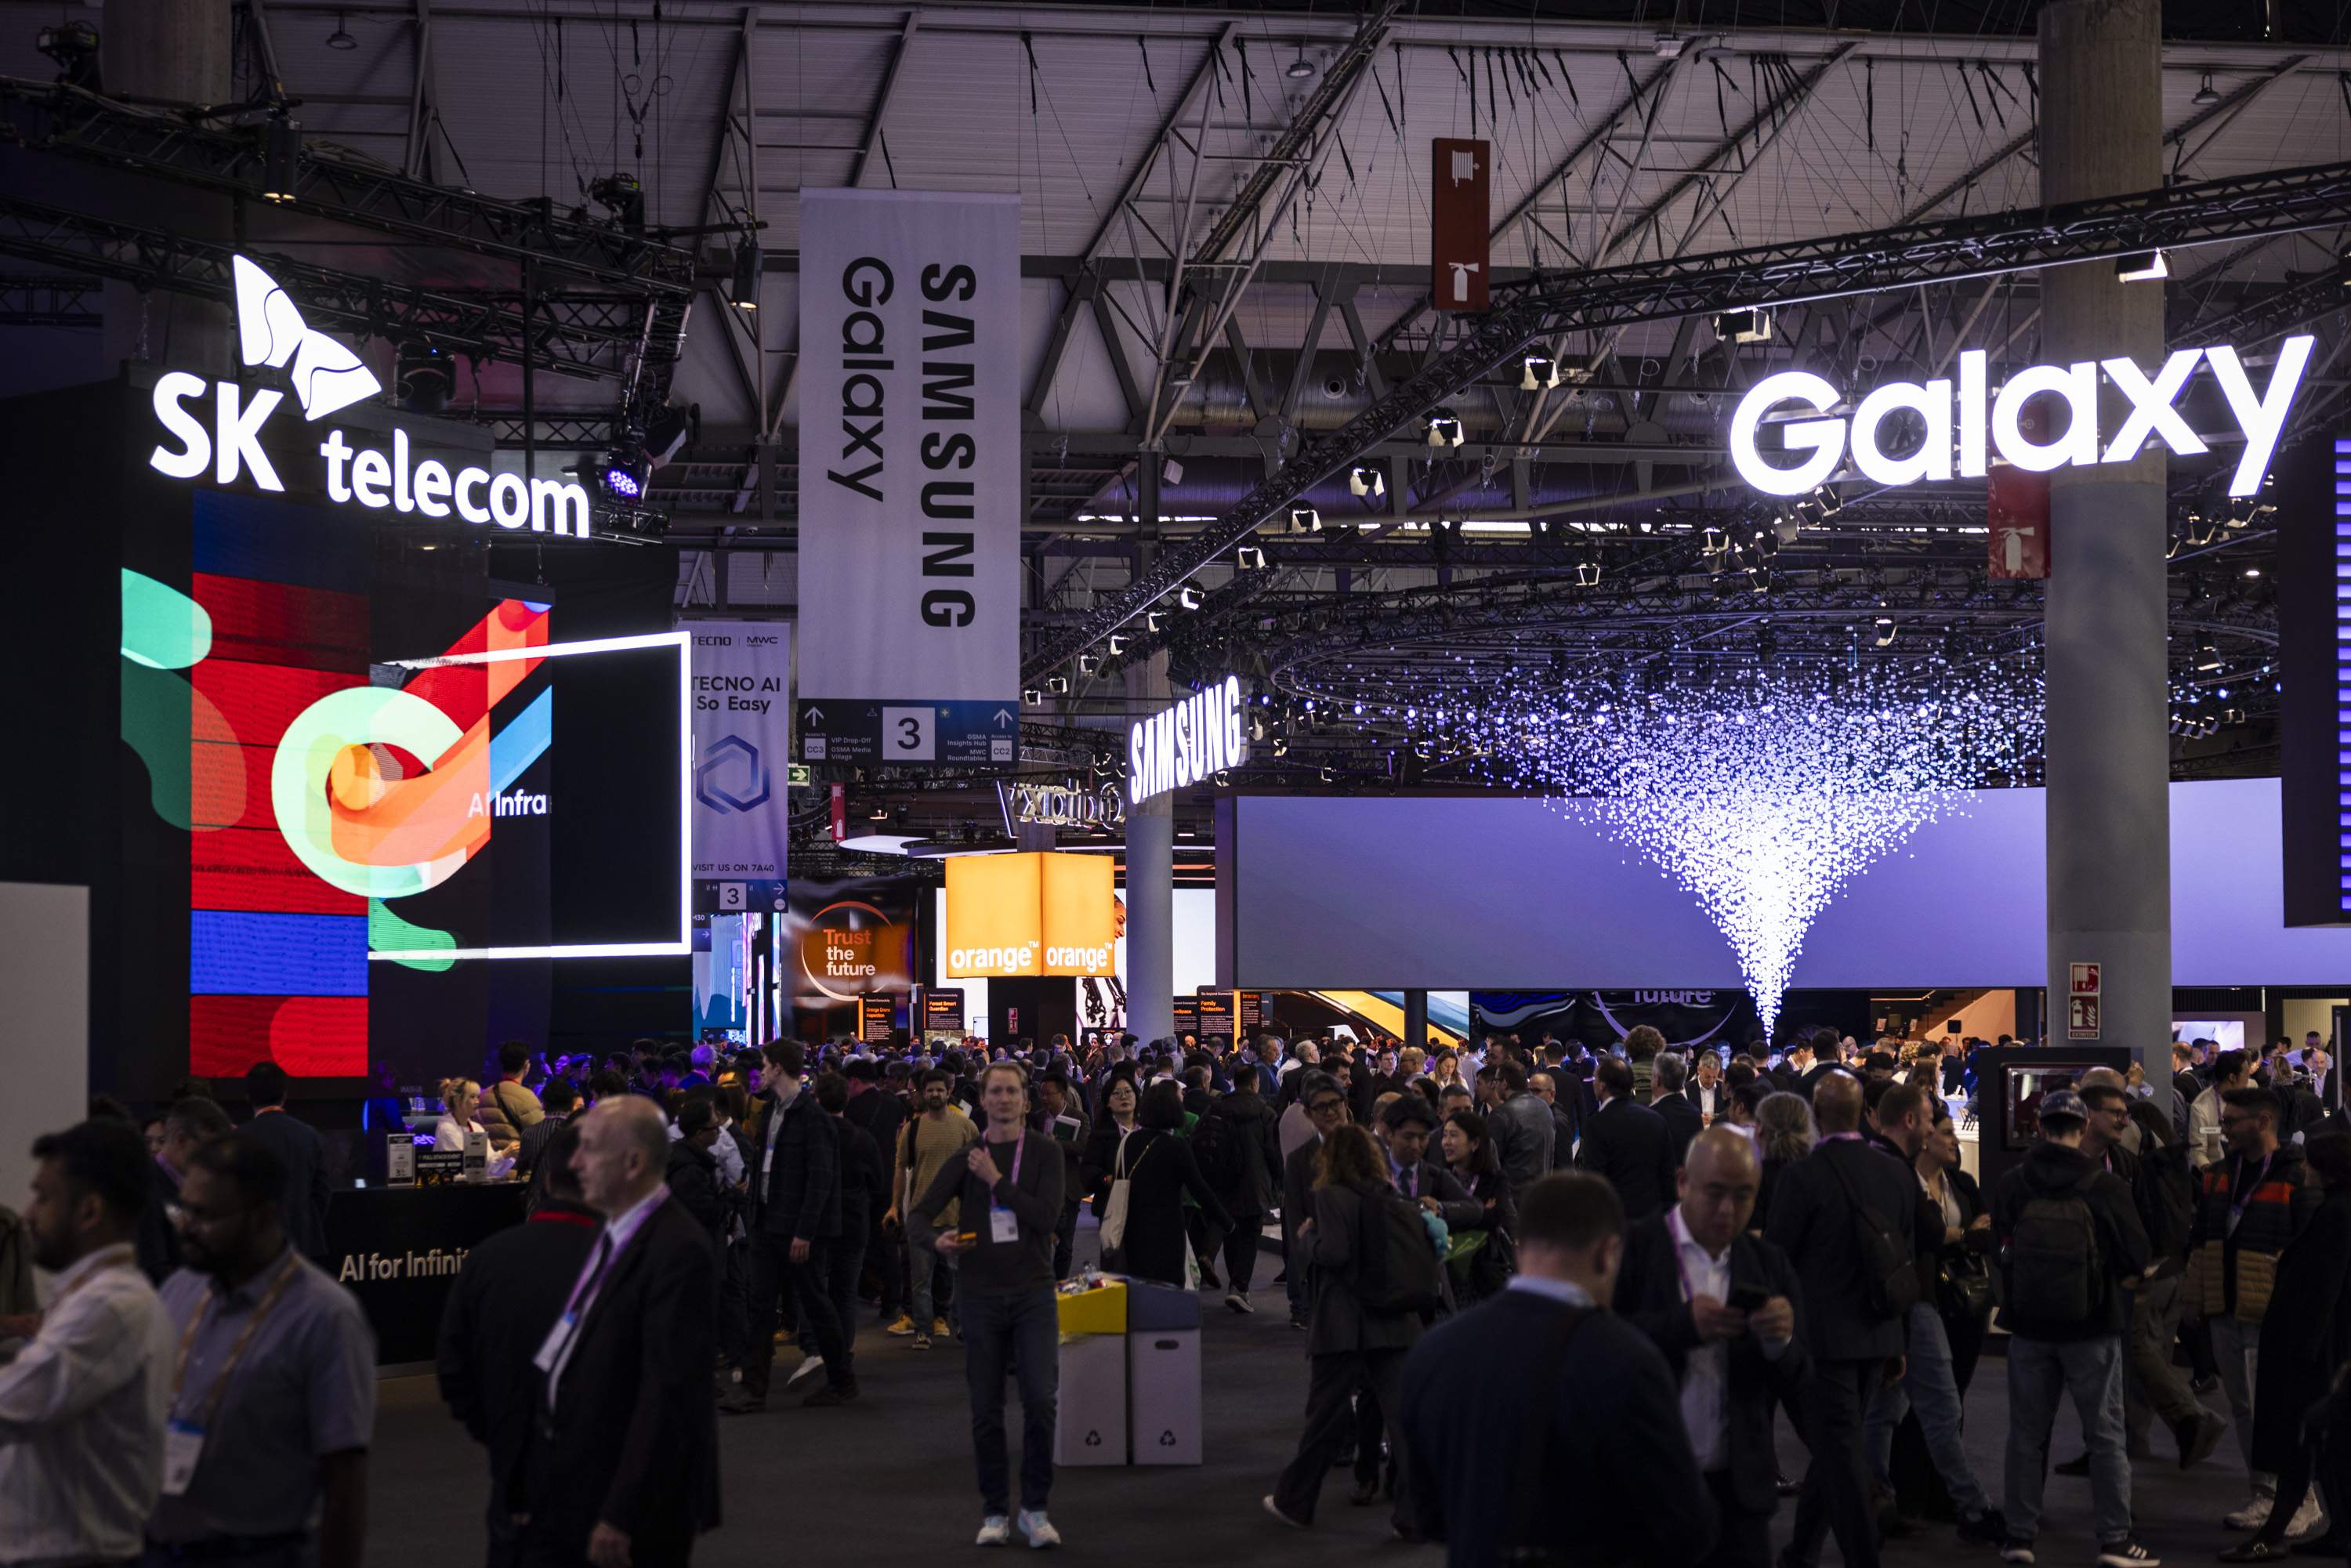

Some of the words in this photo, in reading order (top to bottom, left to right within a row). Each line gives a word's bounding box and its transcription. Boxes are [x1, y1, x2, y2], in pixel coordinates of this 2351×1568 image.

[828, 257, 894, 502] Galaxy
[1729, 335, 2317, 498] Galaxy
[150, 371, 284, 492] SK
[320, 427, 590, 539] telecom
[921, 263, 976, 627] SAMSUNG
[746, 636, 778, 645] MWC
[691, 676, 755, 691] TECNO
[760, 676, 781, 692] AI
[696, 695, 719, 711] So
[727, 695, 772, 715] Easy
[897, 717, 921, 750] 3
[1131, 675, 1241, 805] SAMSUNG
[806, 745, 824, 754] CC3
[467, 791, 491, 818] AI
[494, 788, 547, 817] Infra
[693, 863, 715, 871] VISIT
[734, 864, 748, 872] ON
[726, 887, 739, 905] 3
[823, 929, 871, 945] Trust
[826, 946, 855, 961] the
[826, 961, 876, 976] future
[339, 1254, 364, 1282] AI
[368, 1252, 404, 1280] for
[407, 1248, 469, 1277] Infini
